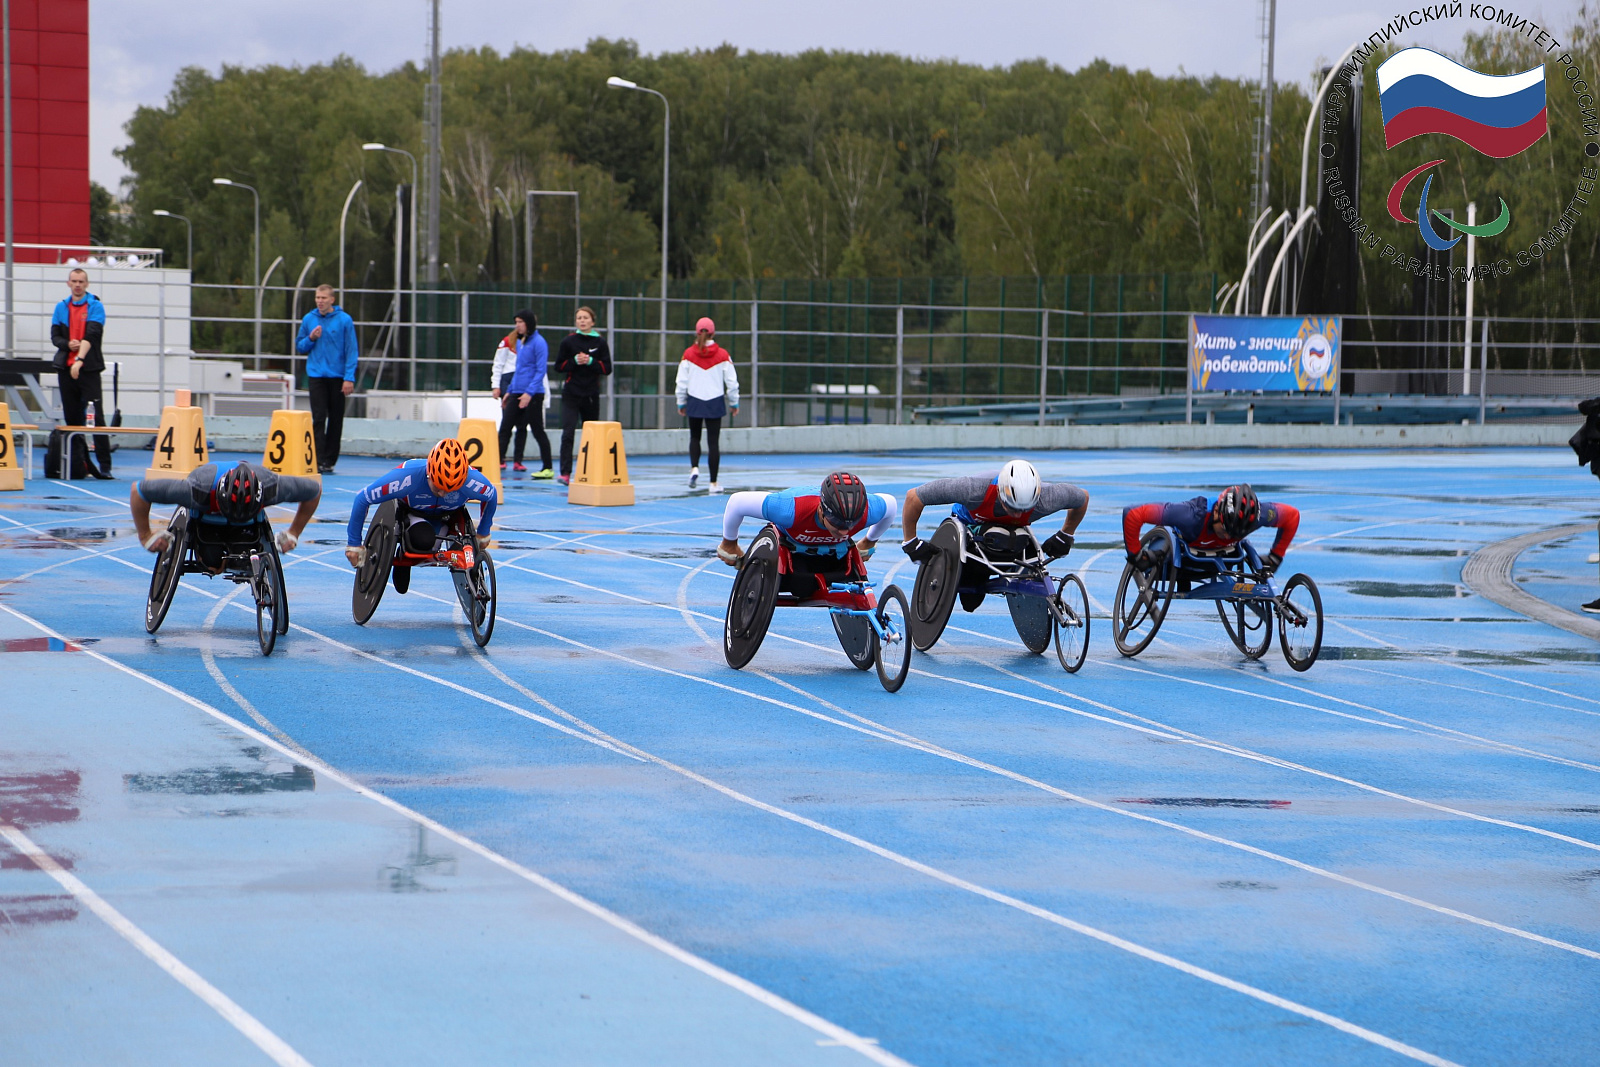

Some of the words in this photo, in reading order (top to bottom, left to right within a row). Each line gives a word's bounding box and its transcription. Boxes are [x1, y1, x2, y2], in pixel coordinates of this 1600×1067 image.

[1194, 333, 1237, 350] Жить
[1248, 337, 1303, 351] значит
[1203, 355, 1293, 374] побеждать!
[160, 426, 174, 461] 4
[194, 427, 204, 461] 4
[269, 429, 286, 465] 3
[304, 430, 313, 466] 3
[464, 438, 483, 473] 2
[582, 441, 589, 475] 1
[609, 441, 618, 476] 1
